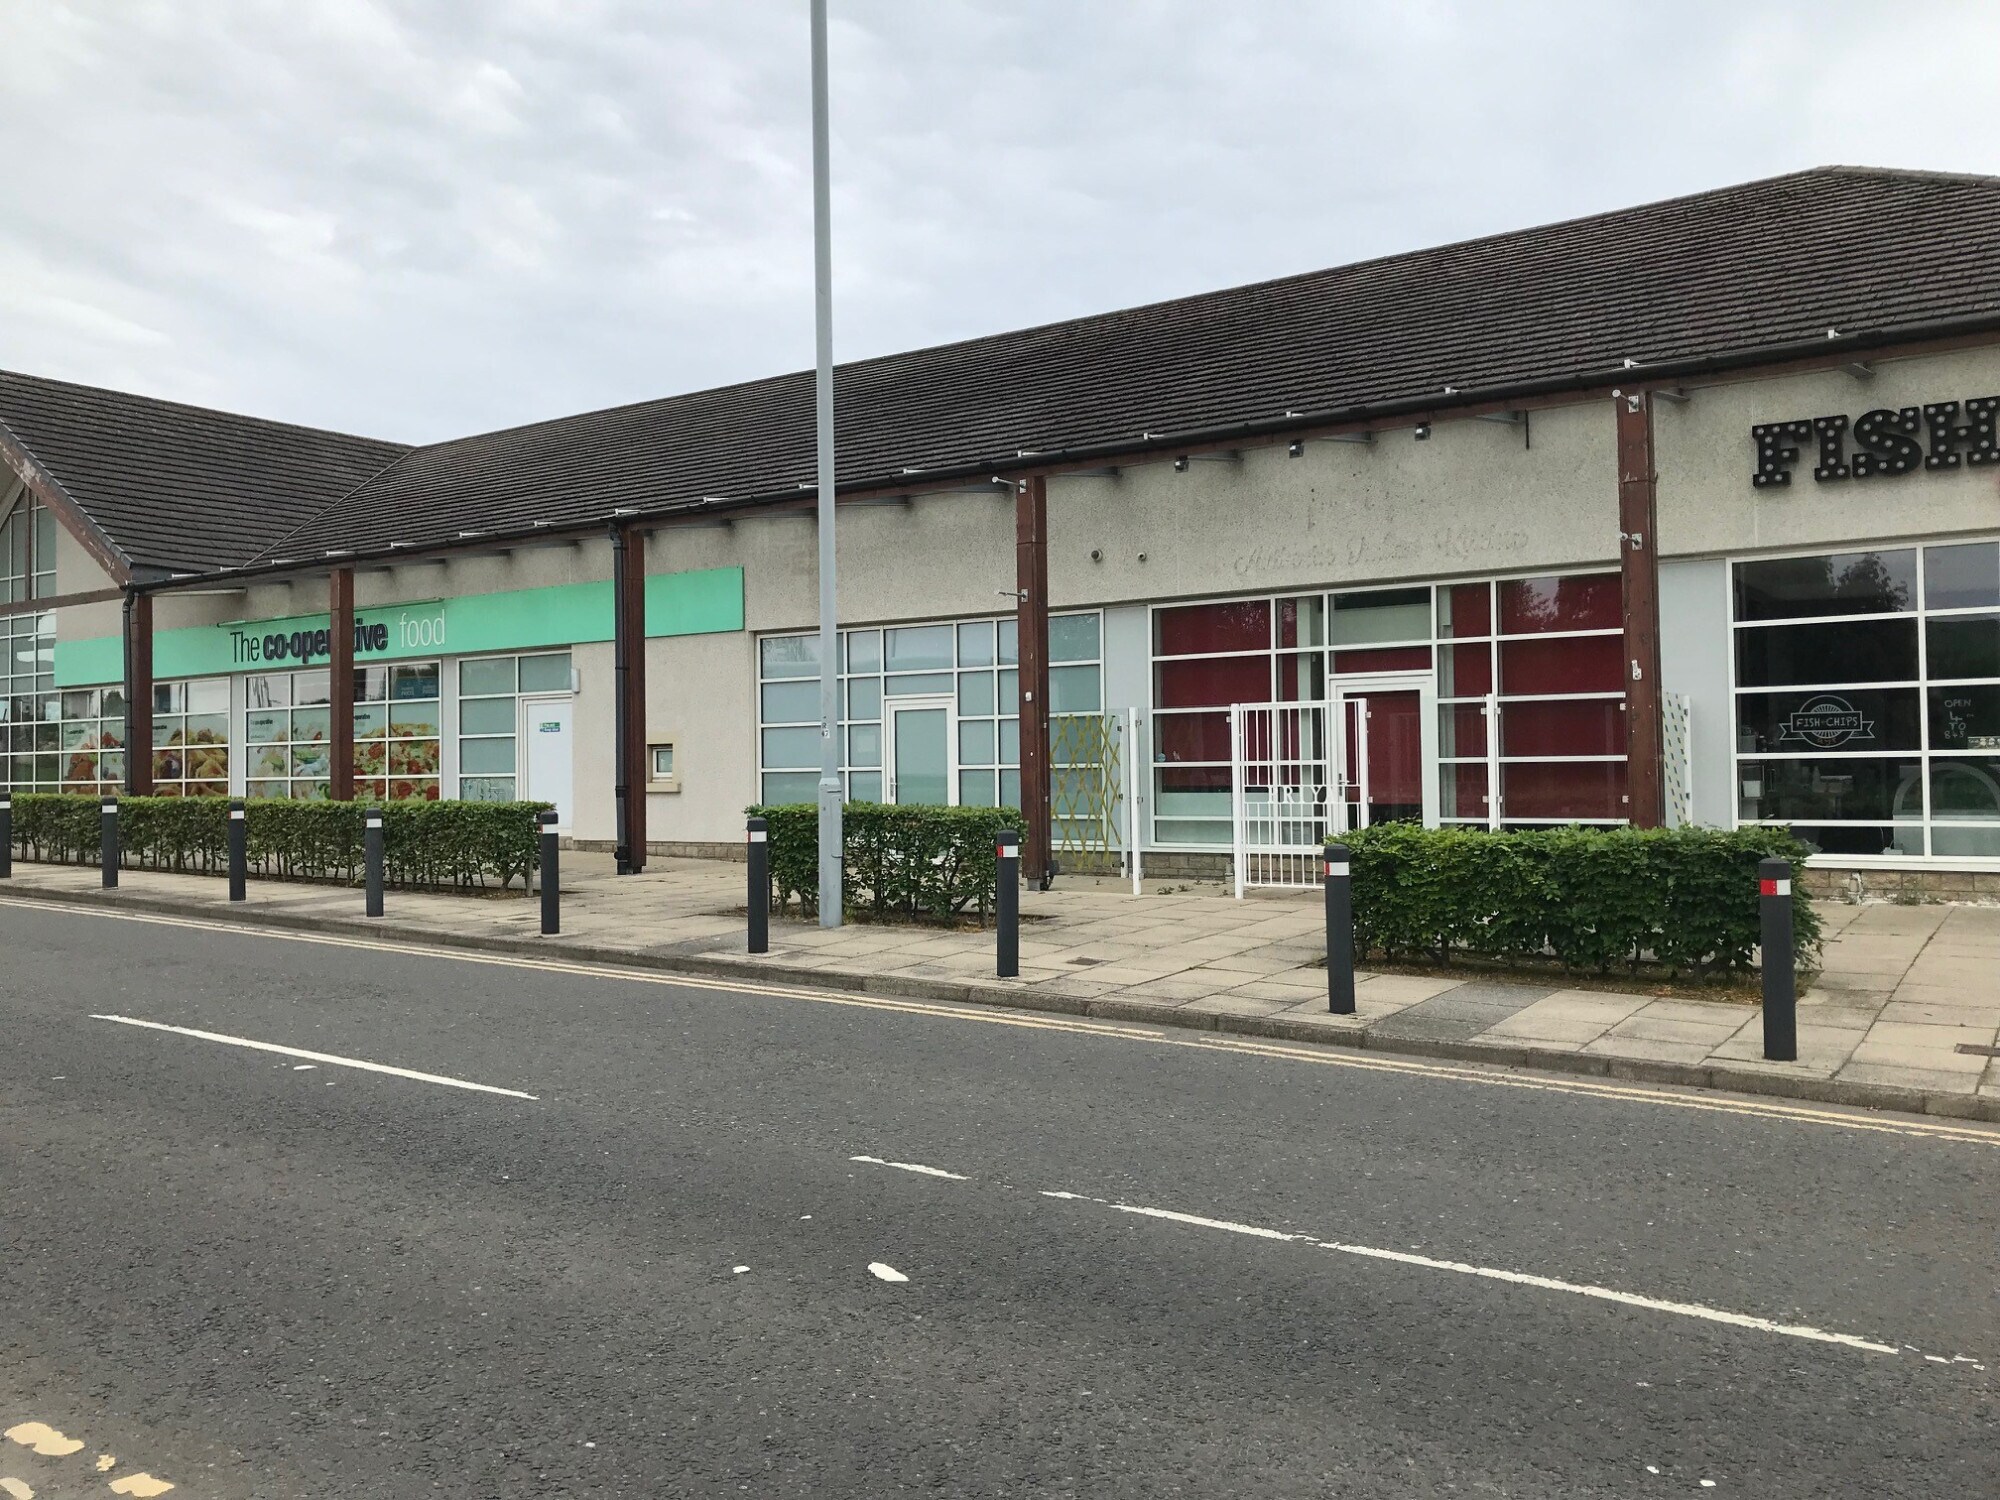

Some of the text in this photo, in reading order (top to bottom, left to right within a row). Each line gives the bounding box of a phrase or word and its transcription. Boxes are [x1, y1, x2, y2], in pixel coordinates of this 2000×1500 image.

[1752, 395, 2000, 487] FISH
[230, 609, 445, 665] The co-operive food
[1944, 699, 1971, 708] OPEN
